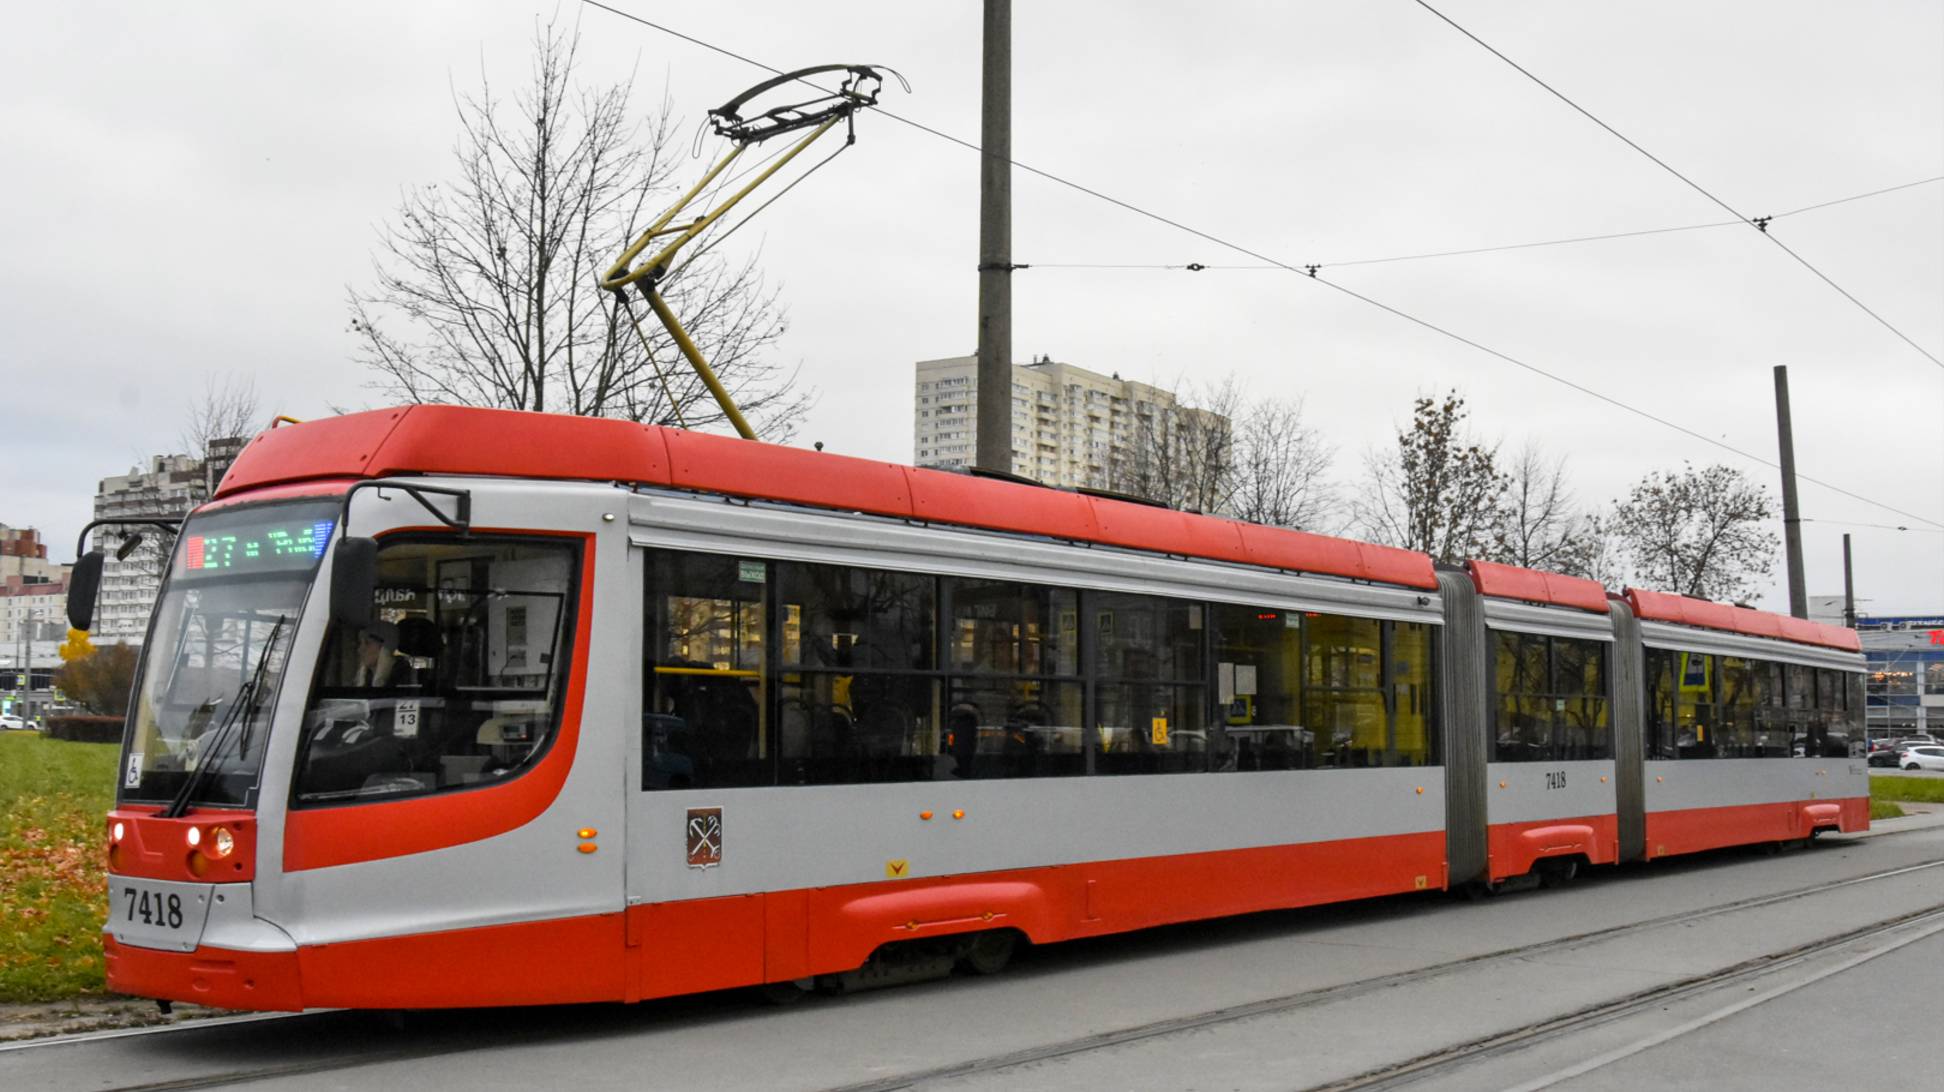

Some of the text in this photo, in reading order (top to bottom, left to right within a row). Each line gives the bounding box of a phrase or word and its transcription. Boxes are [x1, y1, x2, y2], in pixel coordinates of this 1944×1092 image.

[400, 713, 416, 725] 13
[1545, 770, 1567, 790] 7418
[124, 887, 183, 929] 7418
